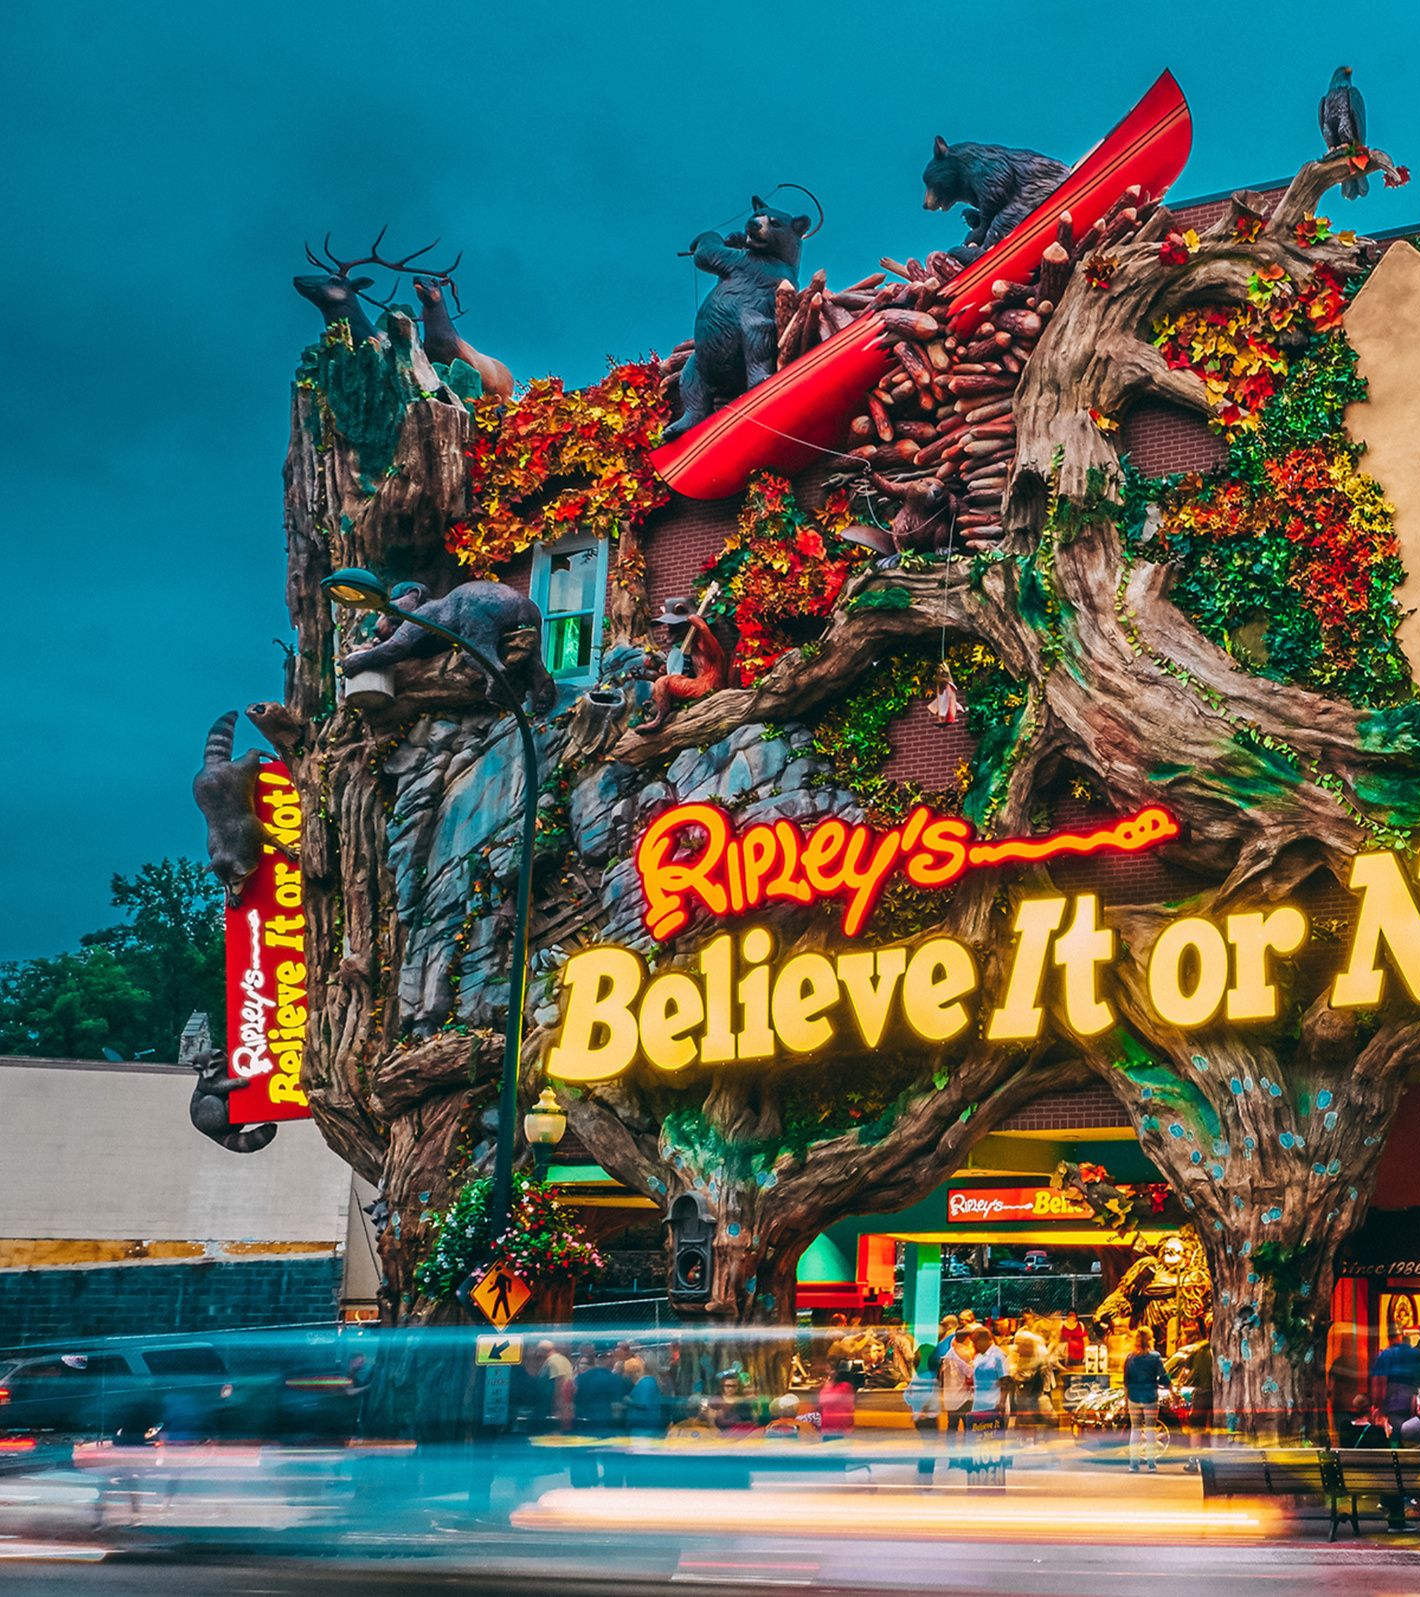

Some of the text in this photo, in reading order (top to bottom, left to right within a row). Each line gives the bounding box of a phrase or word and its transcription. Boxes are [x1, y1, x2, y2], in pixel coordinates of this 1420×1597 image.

[264, 914, 306, 952] It
[274, 862, 302, 908] or
[268, 960, 309, 1107] Believe
[546, 927, 977, 1081] Believe
[987, 893, 1116, 1040] It
[1149, 906, 1307, 1027] or
